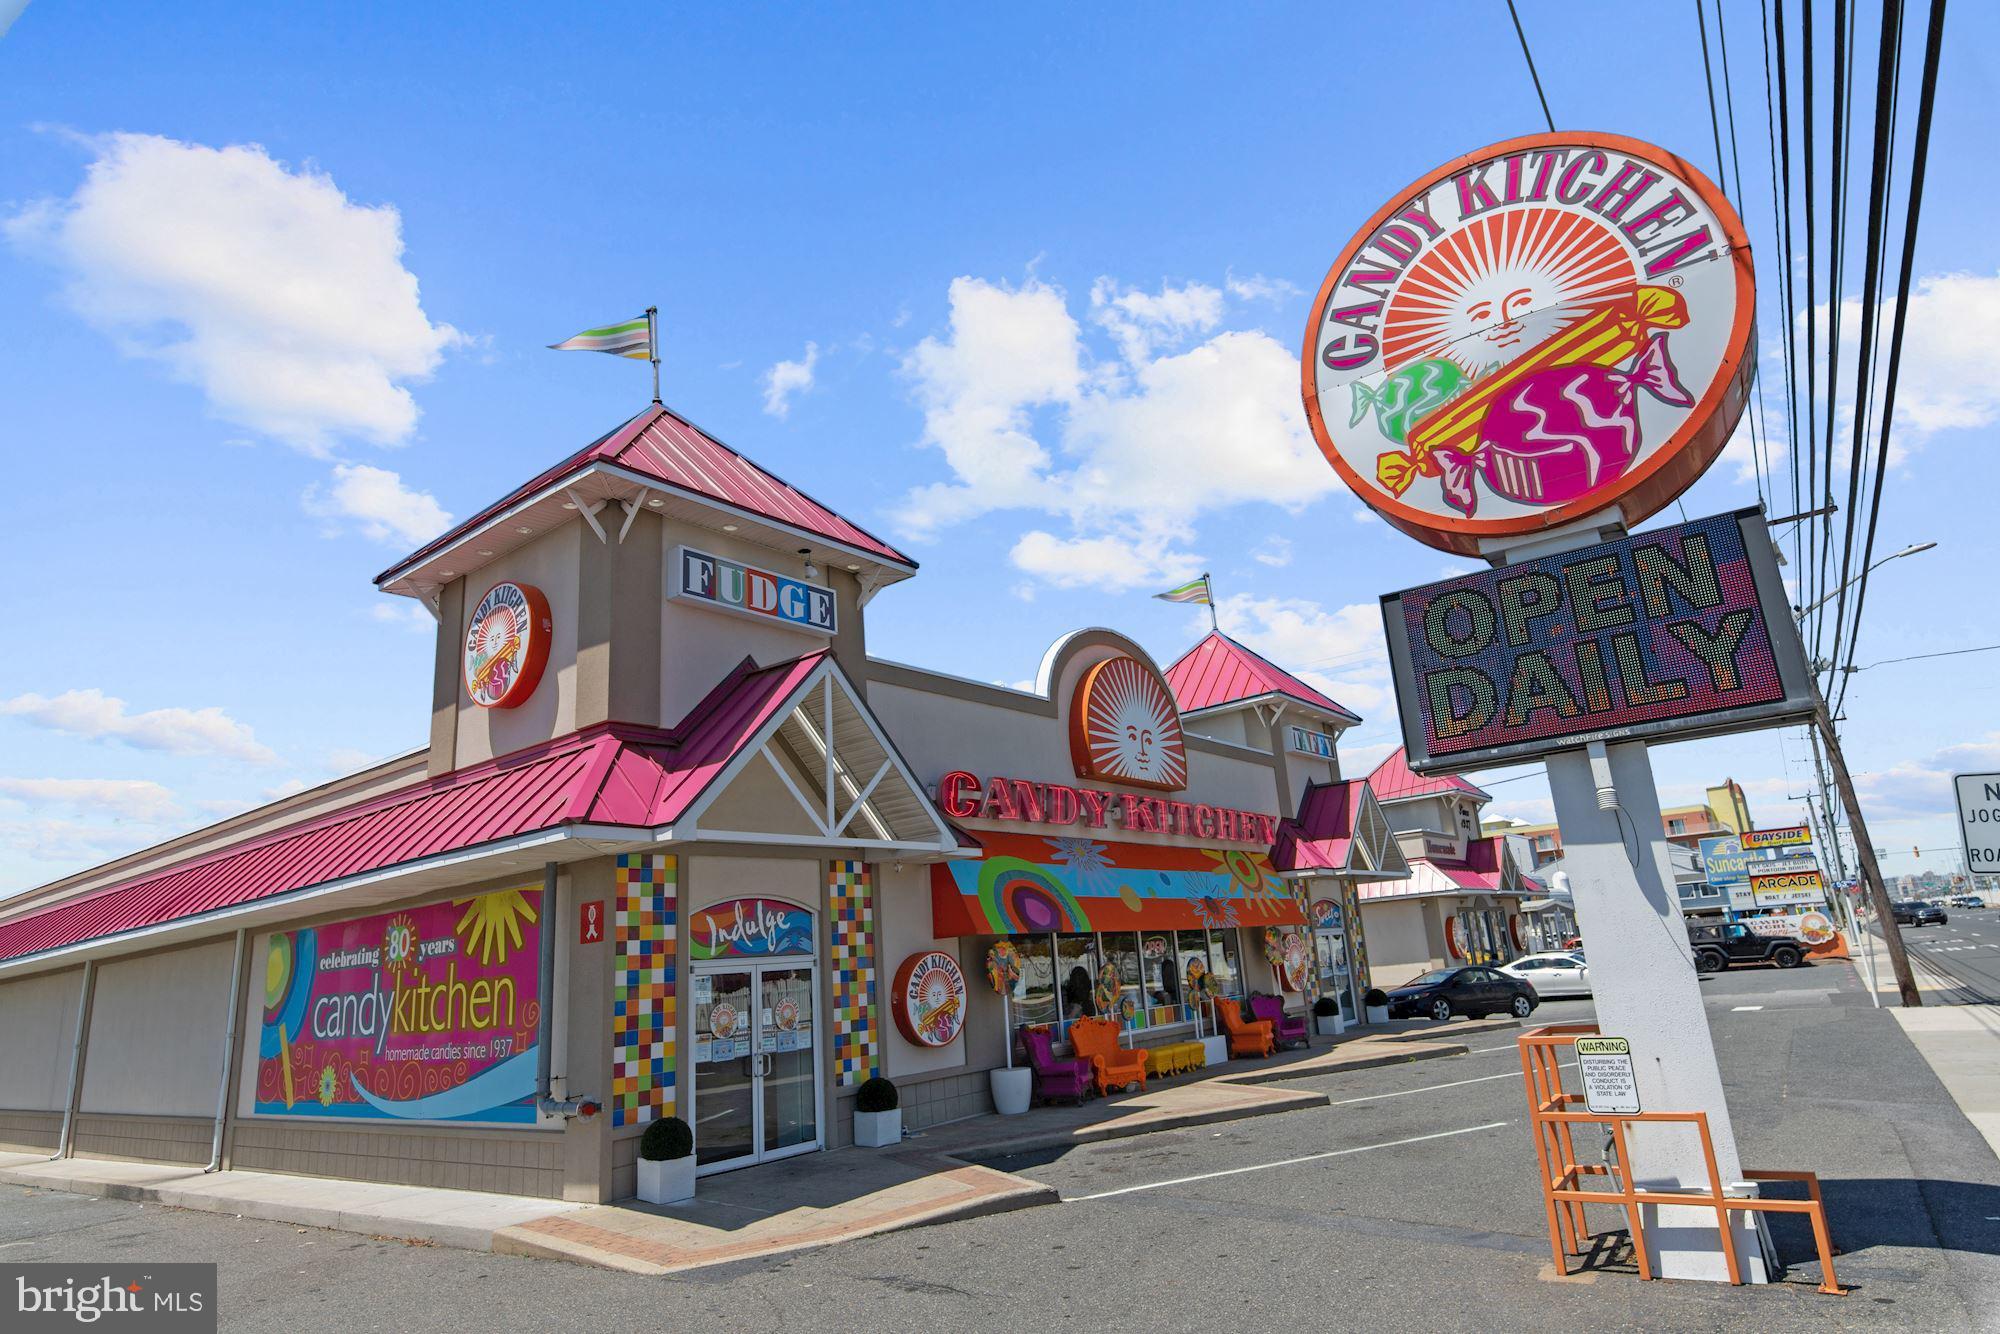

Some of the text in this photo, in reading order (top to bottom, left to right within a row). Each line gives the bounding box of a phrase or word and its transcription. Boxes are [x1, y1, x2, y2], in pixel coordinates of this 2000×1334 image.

[1323, 148, 1719, 371] CANDY KITCHEN
[686, 555, 831, 627] FUDGE
[1424, 532, 1724, 660] OPEN
[467, 585, 528, 652] CANDY KITCHEN
[1424, 610, 1752, 740] DAILY
[940, 770, 1277, 846] CANDY KITCHEN
[1753, 830, 1803, 843] BAYSIDE
[1971, 848, 2000, 862] RO
[1758, 875, 1817, 890] ARCADE
[320, 928, 455, 970] celebrating 80 years
[706, 900, 790, 957] Indulge
[908, 955, 964, 1000] CANDY KITCHEN
[385, 1039, 512, 1061] homemade candies since 1937
[1580, 1041, 1627, 1052] WARNING
